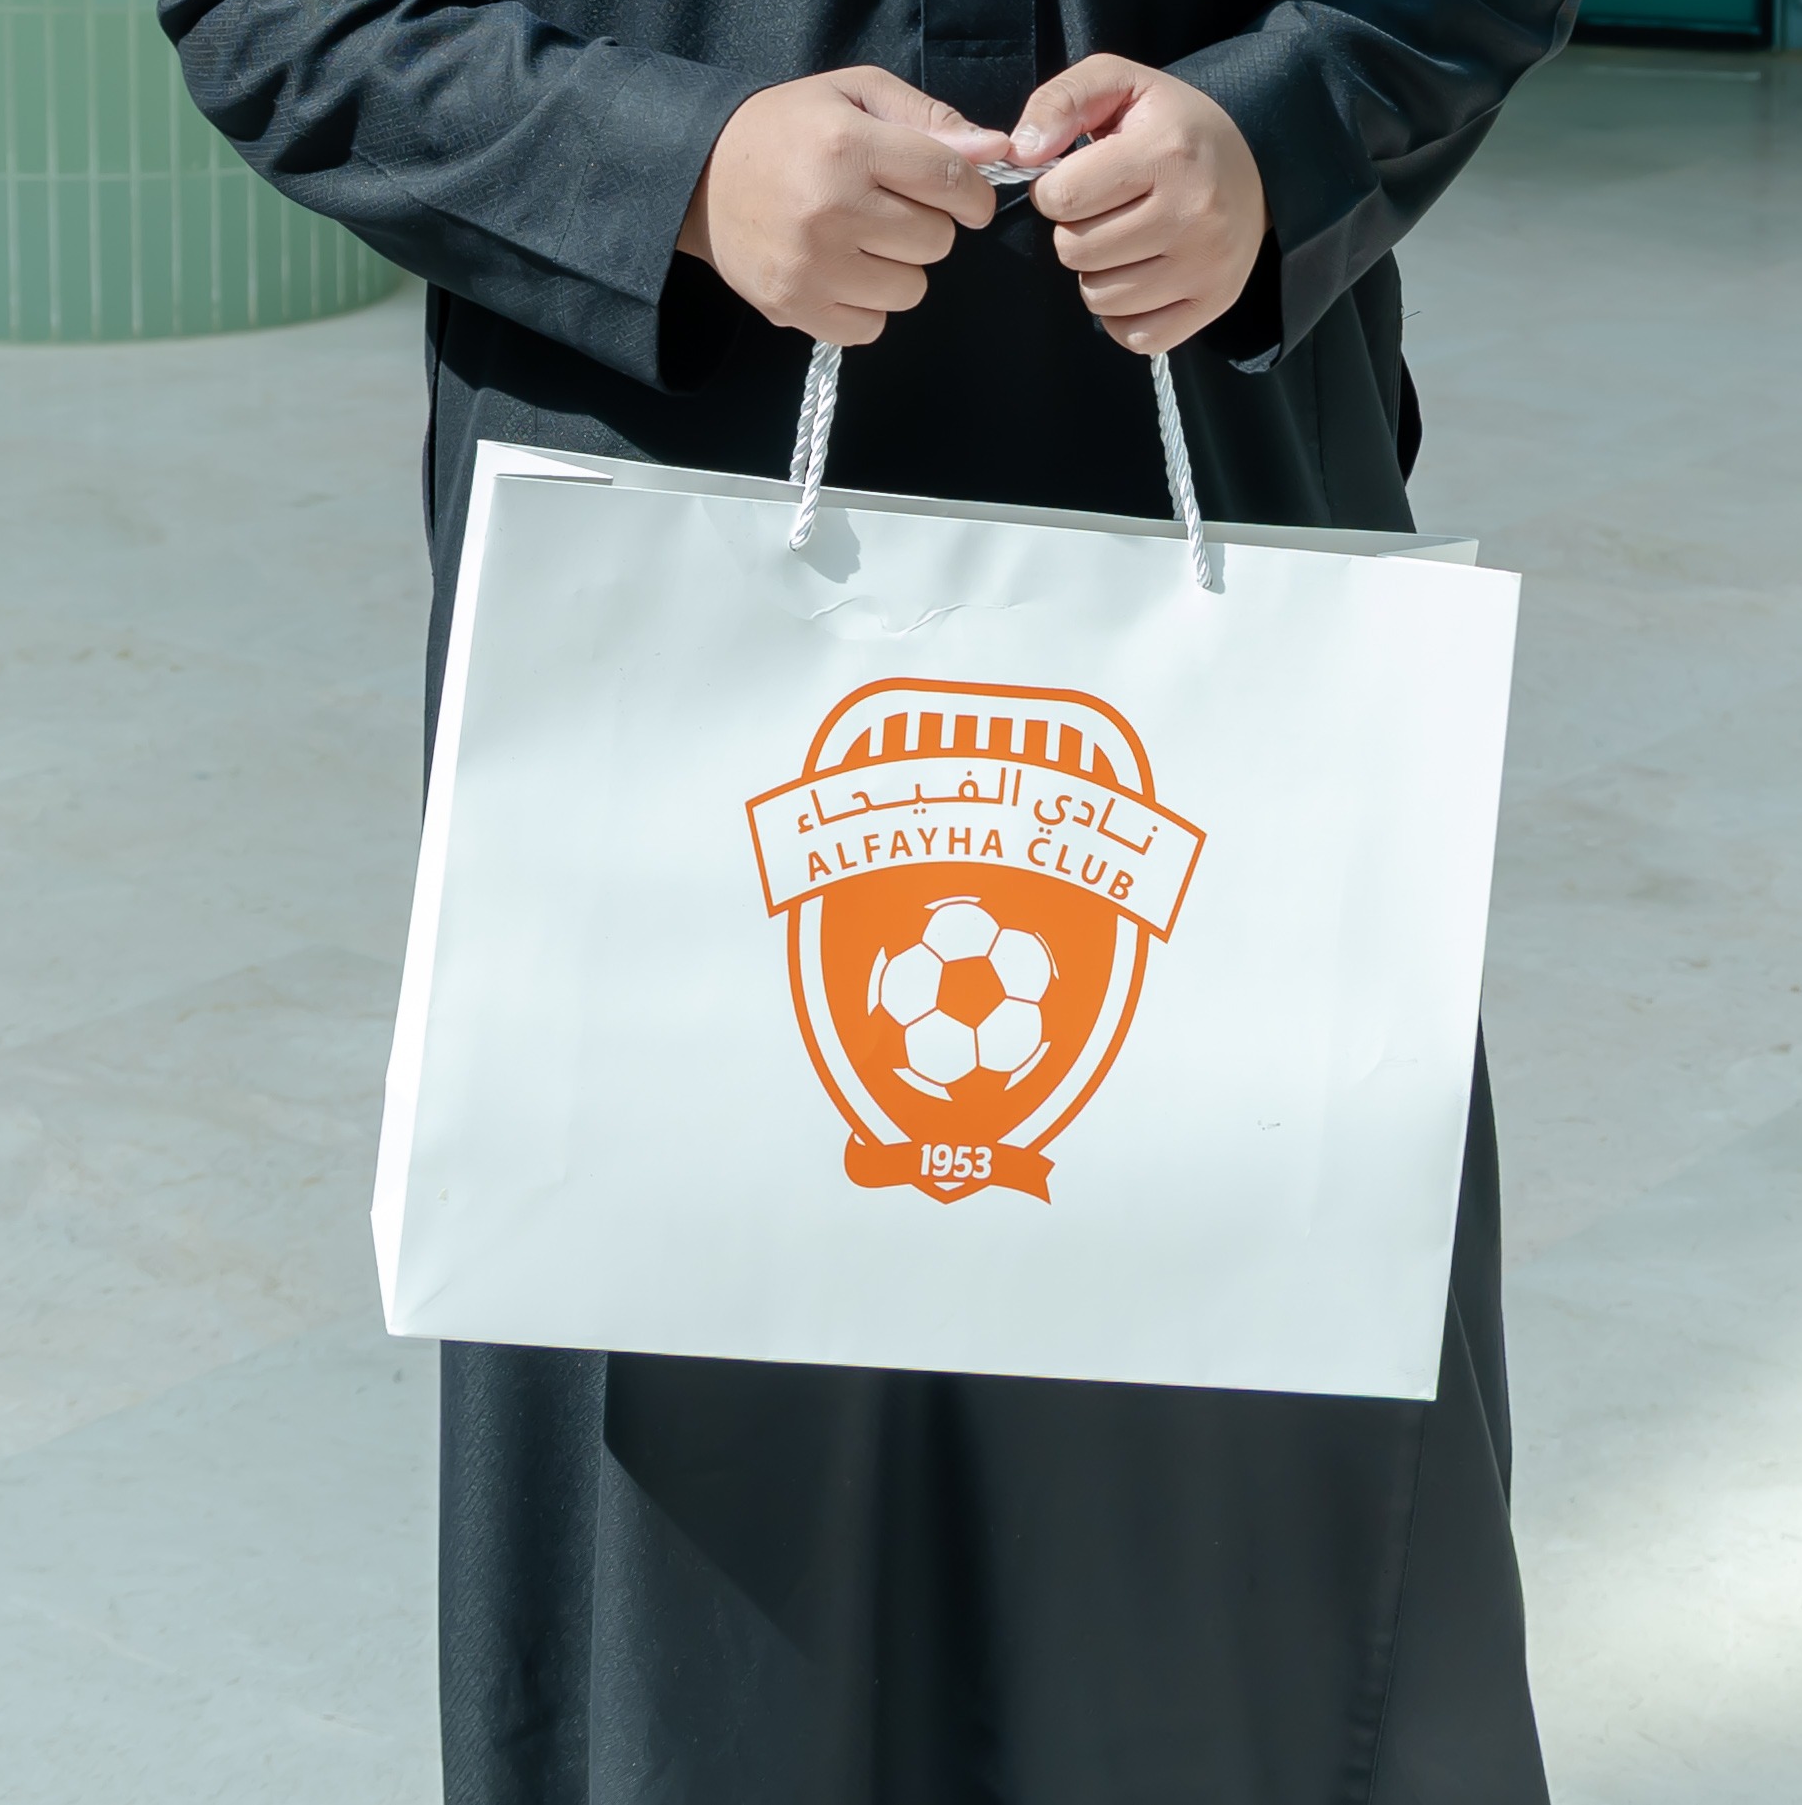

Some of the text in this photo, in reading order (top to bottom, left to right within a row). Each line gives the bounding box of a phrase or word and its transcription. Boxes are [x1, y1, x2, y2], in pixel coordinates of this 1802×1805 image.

[797, 767, 1159, 856] نادي الفيحاء
[808, 827, 1135, 901] ALFAYHA CLUB
[920, 1144, 993, 1180] 1953
